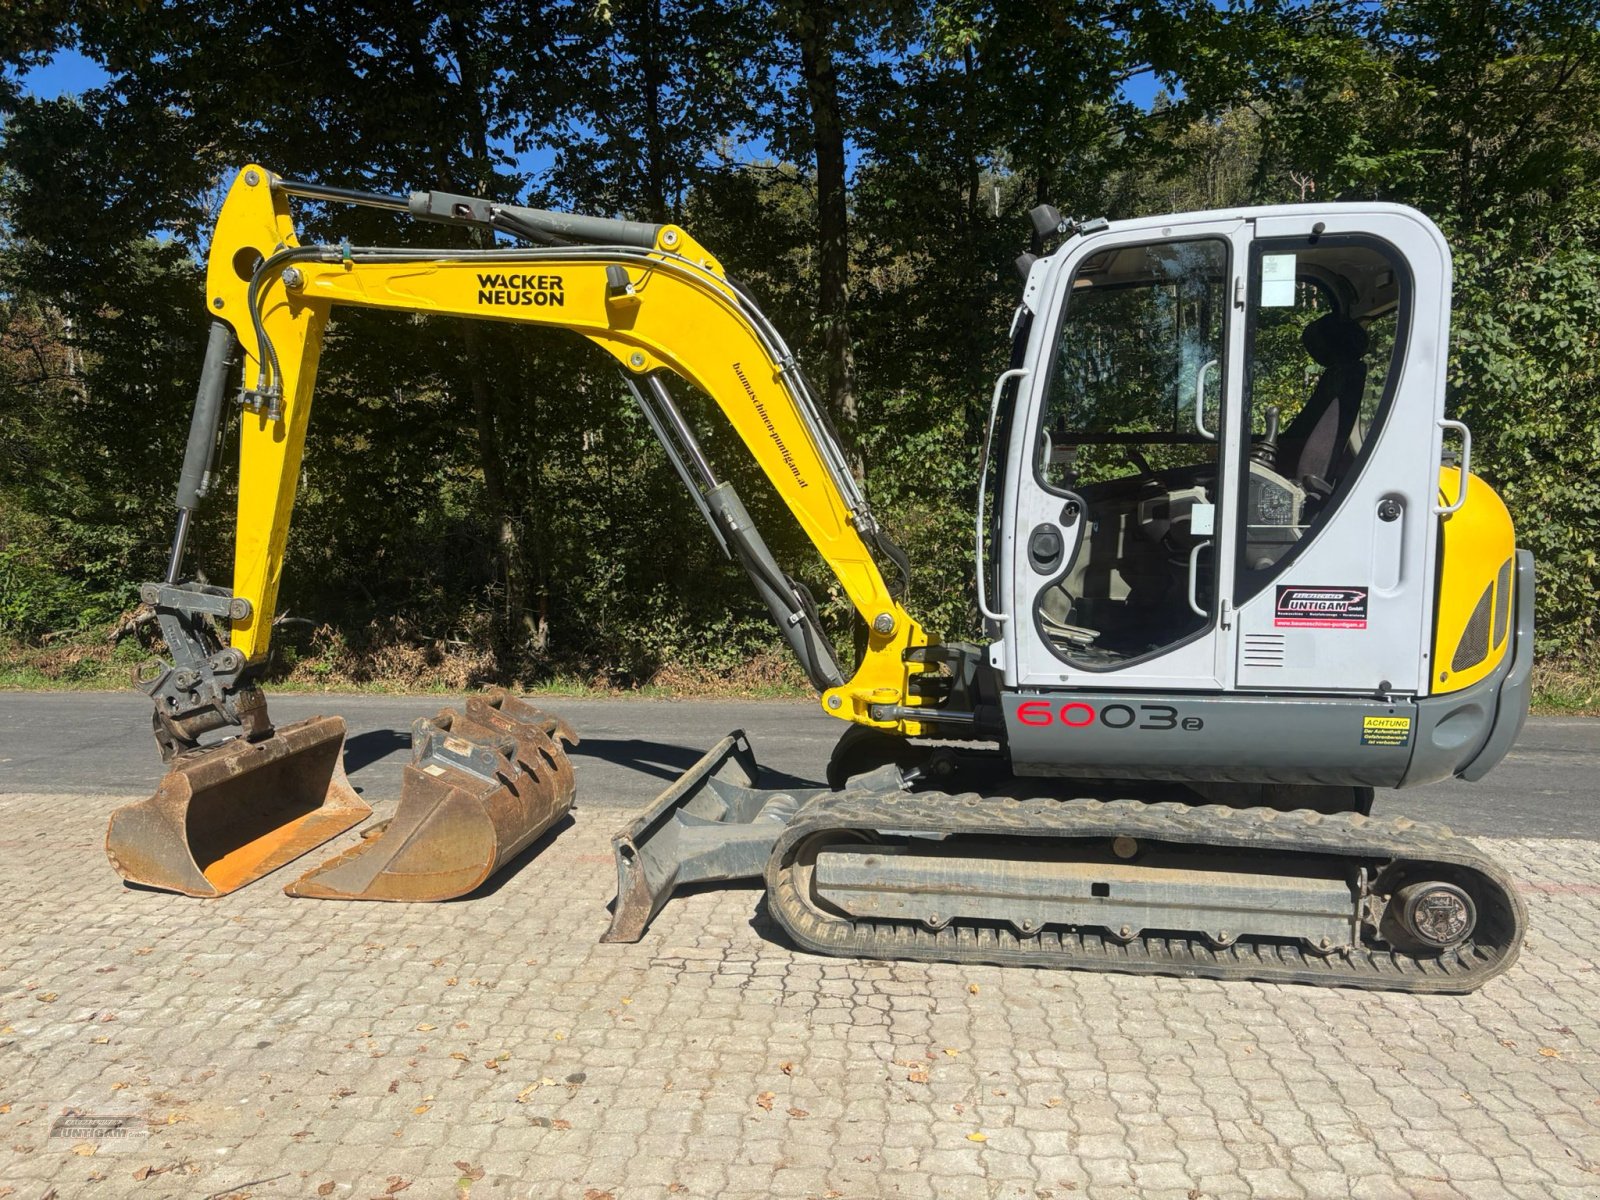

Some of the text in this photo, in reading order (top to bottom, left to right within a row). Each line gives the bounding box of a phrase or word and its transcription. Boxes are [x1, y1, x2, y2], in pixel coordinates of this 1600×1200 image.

[477, 274, 564, 290] WACKER
[478, 290, 564, 306] NEUSON
[732, 362, 808, 488] baumaschinen-puntigam.at
[1366, 719, 1408, 727] ACHTUNG
